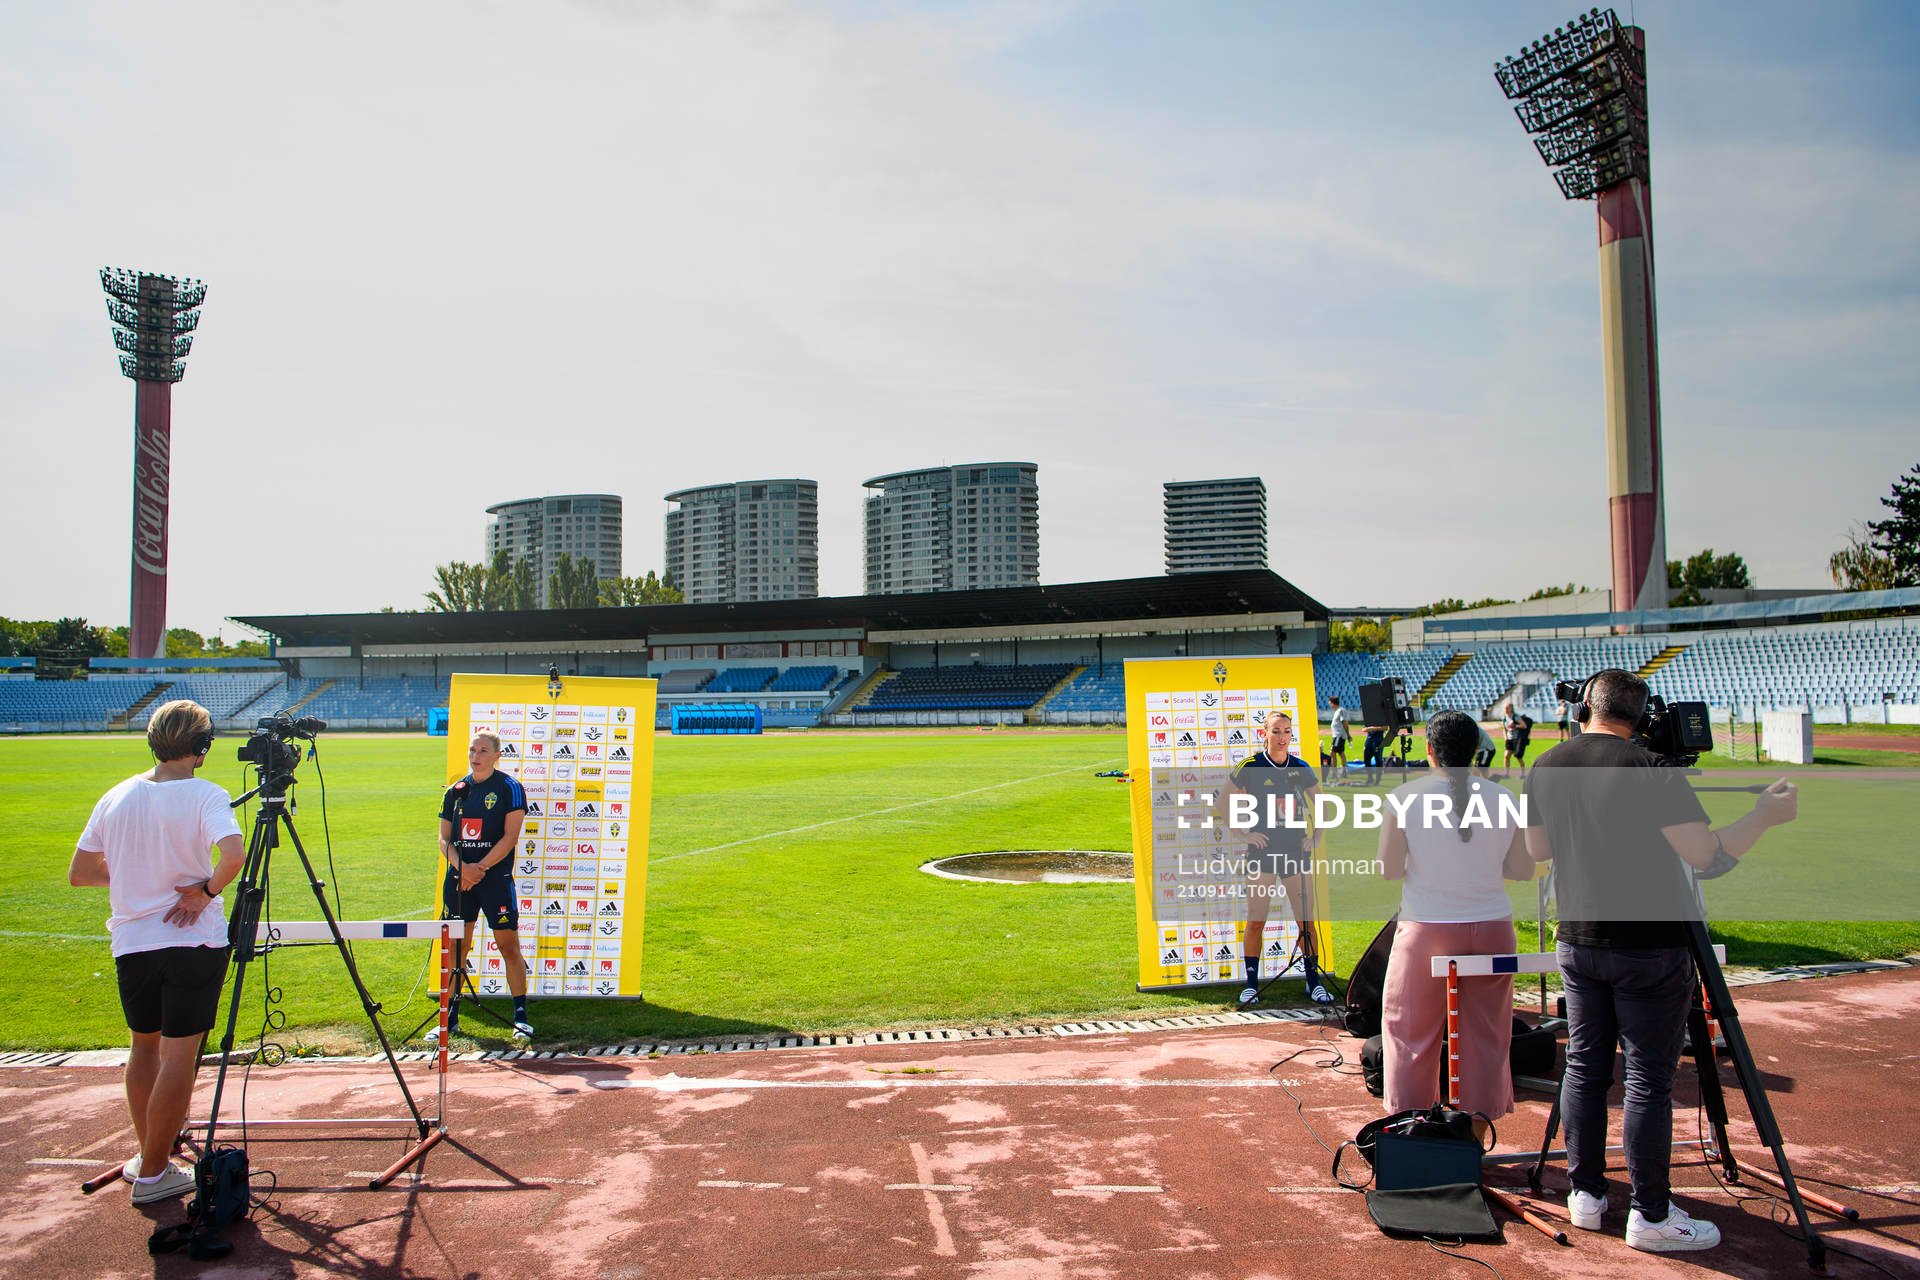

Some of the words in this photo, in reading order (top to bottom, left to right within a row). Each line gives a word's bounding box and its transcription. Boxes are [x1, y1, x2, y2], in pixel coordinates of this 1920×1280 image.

[1152, 716, 1168, 725] ICA
[1181, 774, 1198, 782] ICA
[577, 844, 595, 854] ICA
[1160, 872, 1177, 882] ICA
[1190, 929, 1206, 940] ICA
[487, 942, 499, 952] IC
